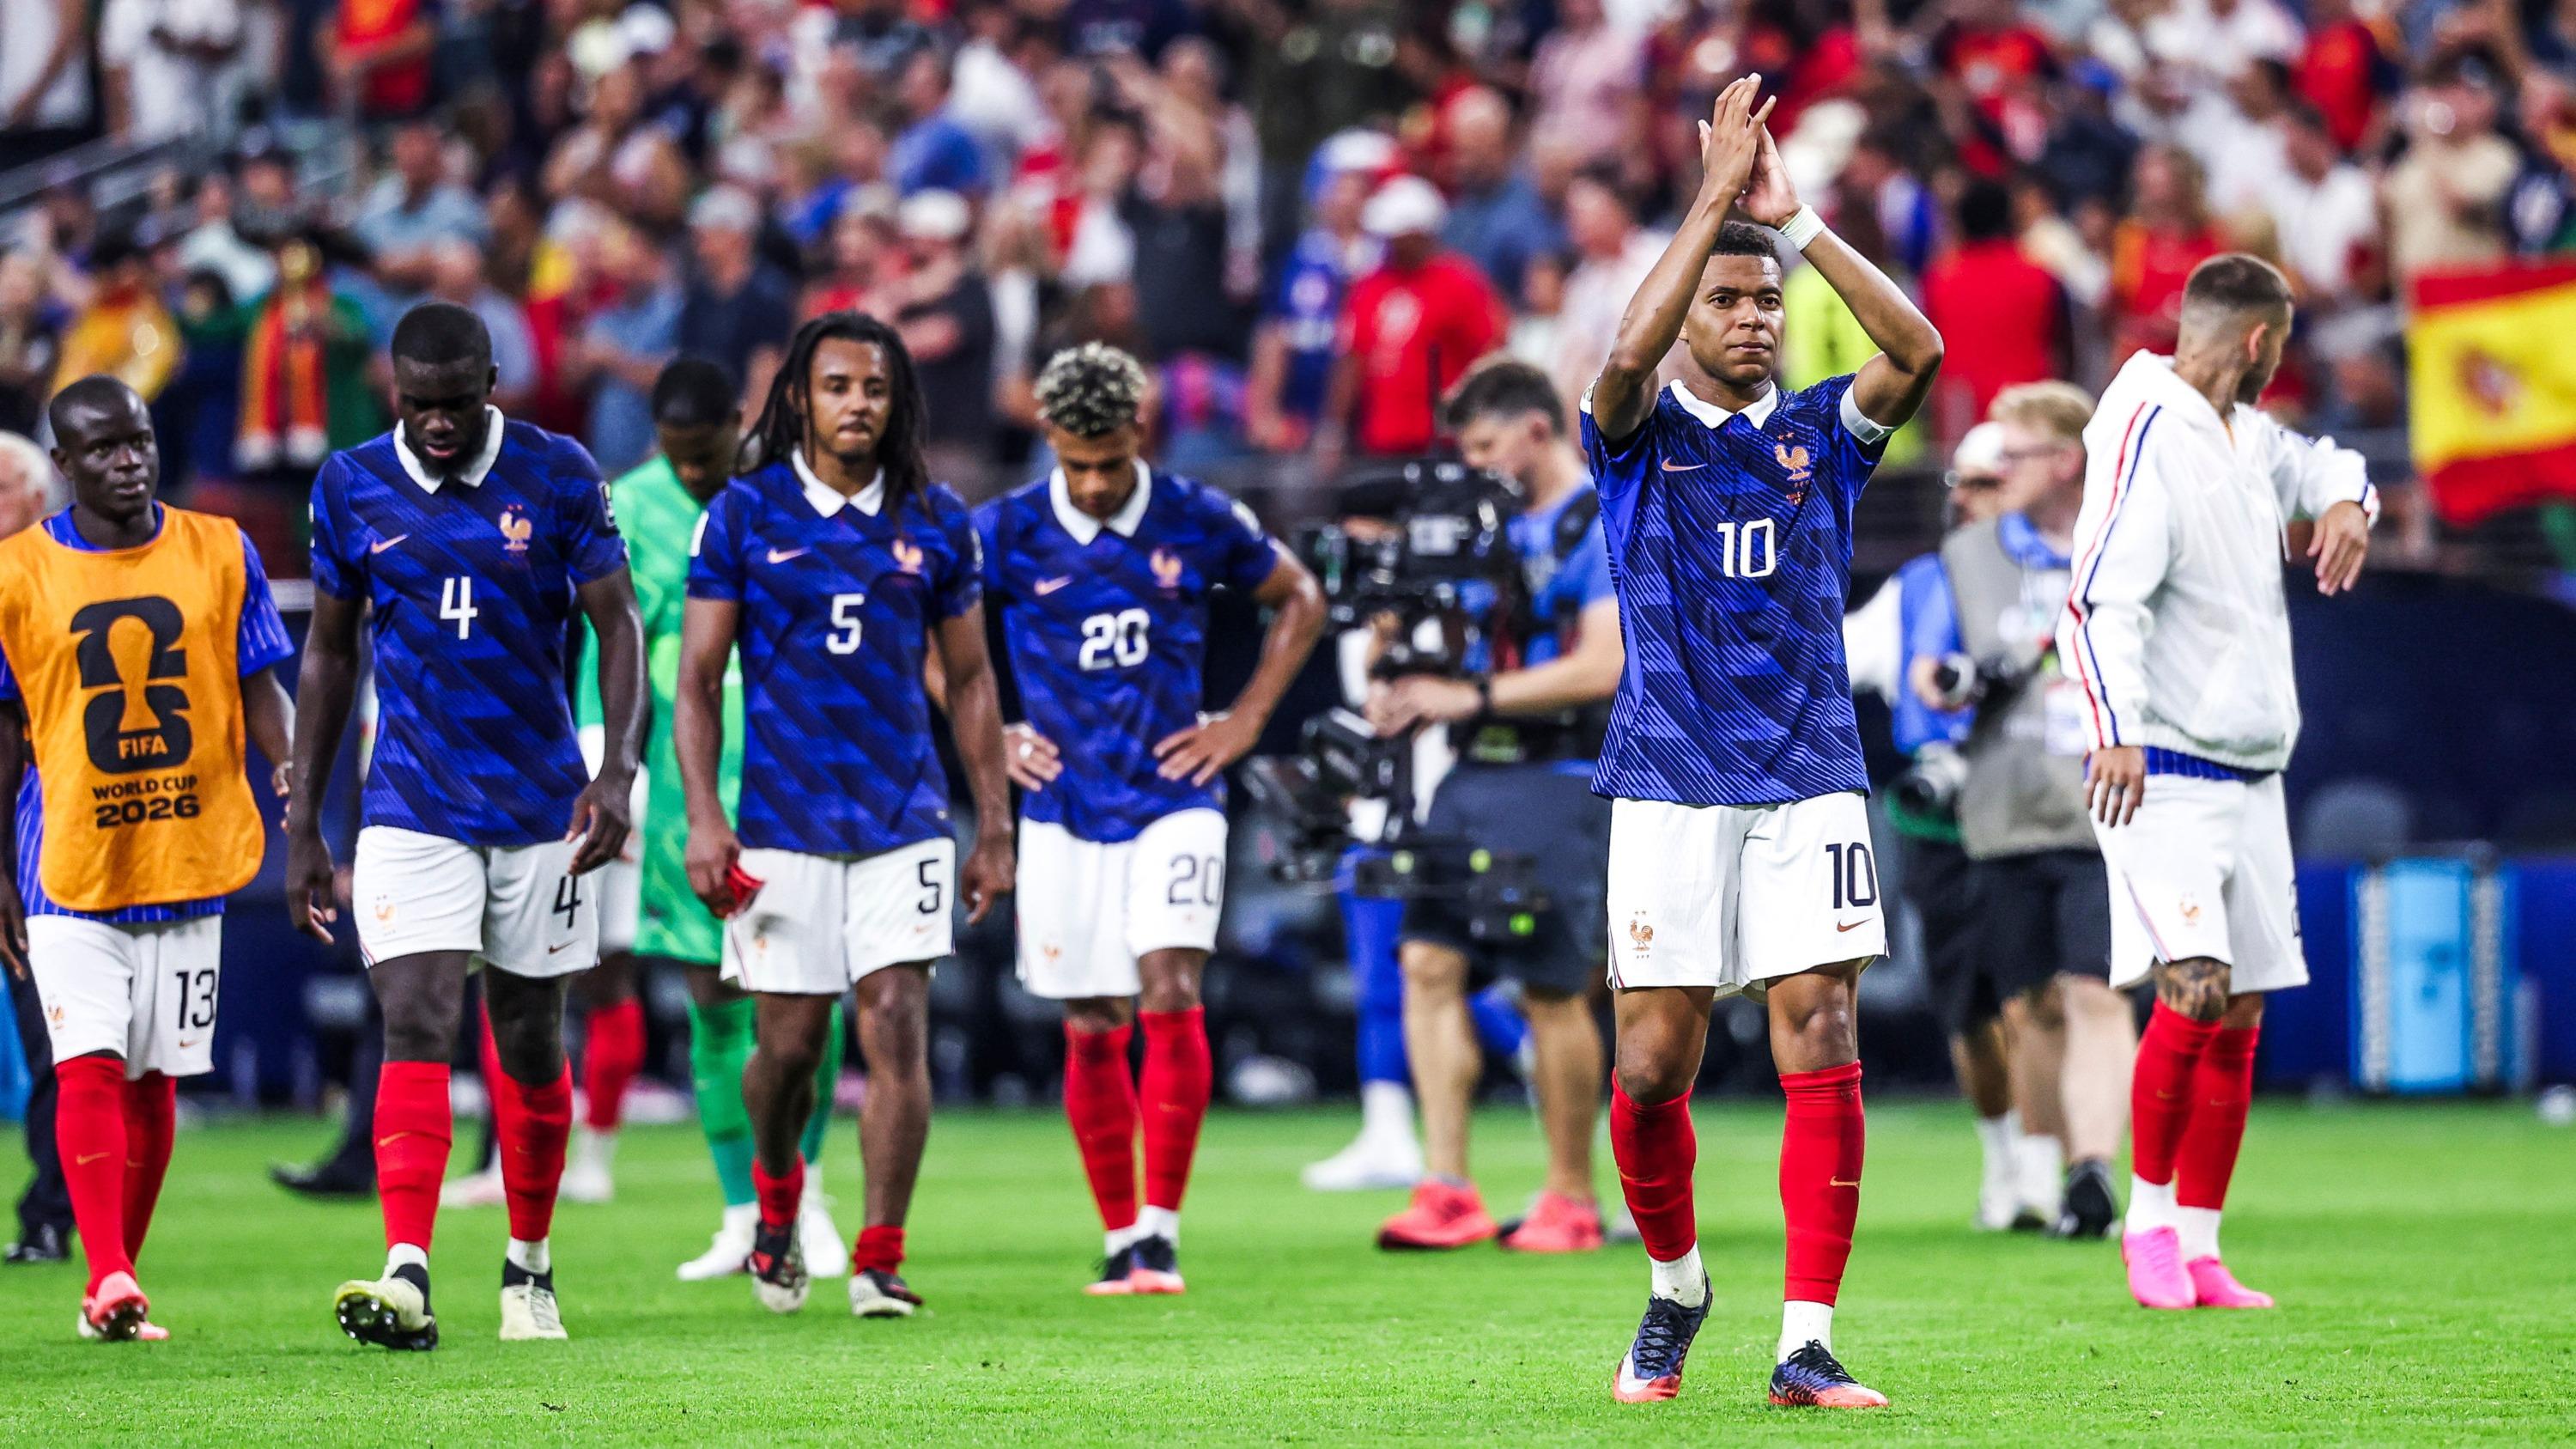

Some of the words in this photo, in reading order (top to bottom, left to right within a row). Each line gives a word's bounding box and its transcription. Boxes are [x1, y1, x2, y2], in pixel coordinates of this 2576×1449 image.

[1716, 517, 1777, 578] 10
[440, 575, 478, 641] 4
[826, 593, 866, 654] 5
[1078, 607, 1150, 671] 20
[117, 734, 169, 760] FIFA
[92, 777, 159, 801] WORLD
[162, 775, 198, 792] CUP
[94, 793, 202, 830] 2026
[552, 875, 582, 929] 4
[918, 857, 941, 915] 5
[1168, 853, 1224, 906] 20
[1825, 842, 1876, 910] 10
[175, 968, 216, 1030] 13
